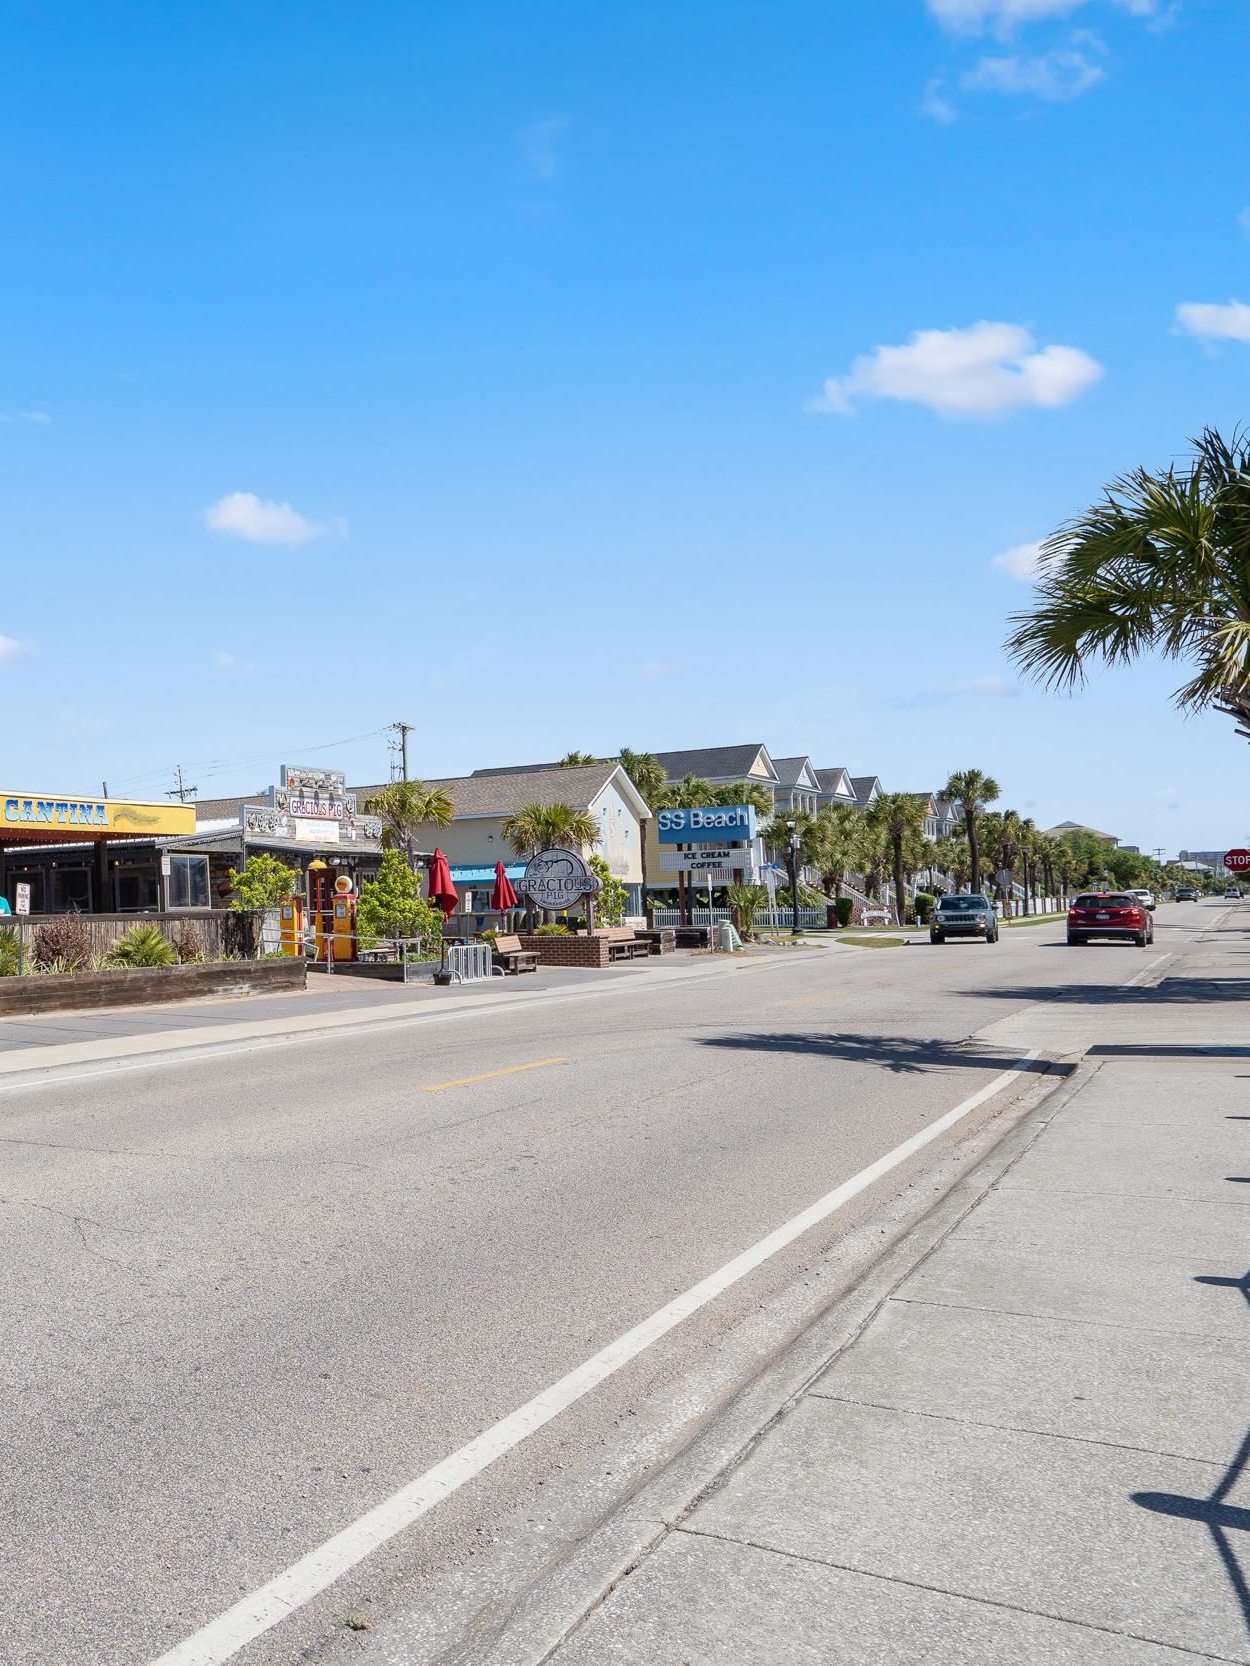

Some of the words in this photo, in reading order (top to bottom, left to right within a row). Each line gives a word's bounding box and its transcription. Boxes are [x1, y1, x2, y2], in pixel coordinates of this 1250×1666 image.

[4, 799, 108, 826] CANTINA
[291, 800, 327, 816] GRACIOUS
[328, 803, 342, 817] PIG
[658, 812, 685, 831] SS
[690, 808, 749, 829] Beach
[684, 852, 697, 860] ICE
[700, 851, 730, 860] CREAM
[690, 861, 723, 869] COFFEE
[518, 878, 592, 892] GRACIOUS
[546, 891, 564, 900] PIG
